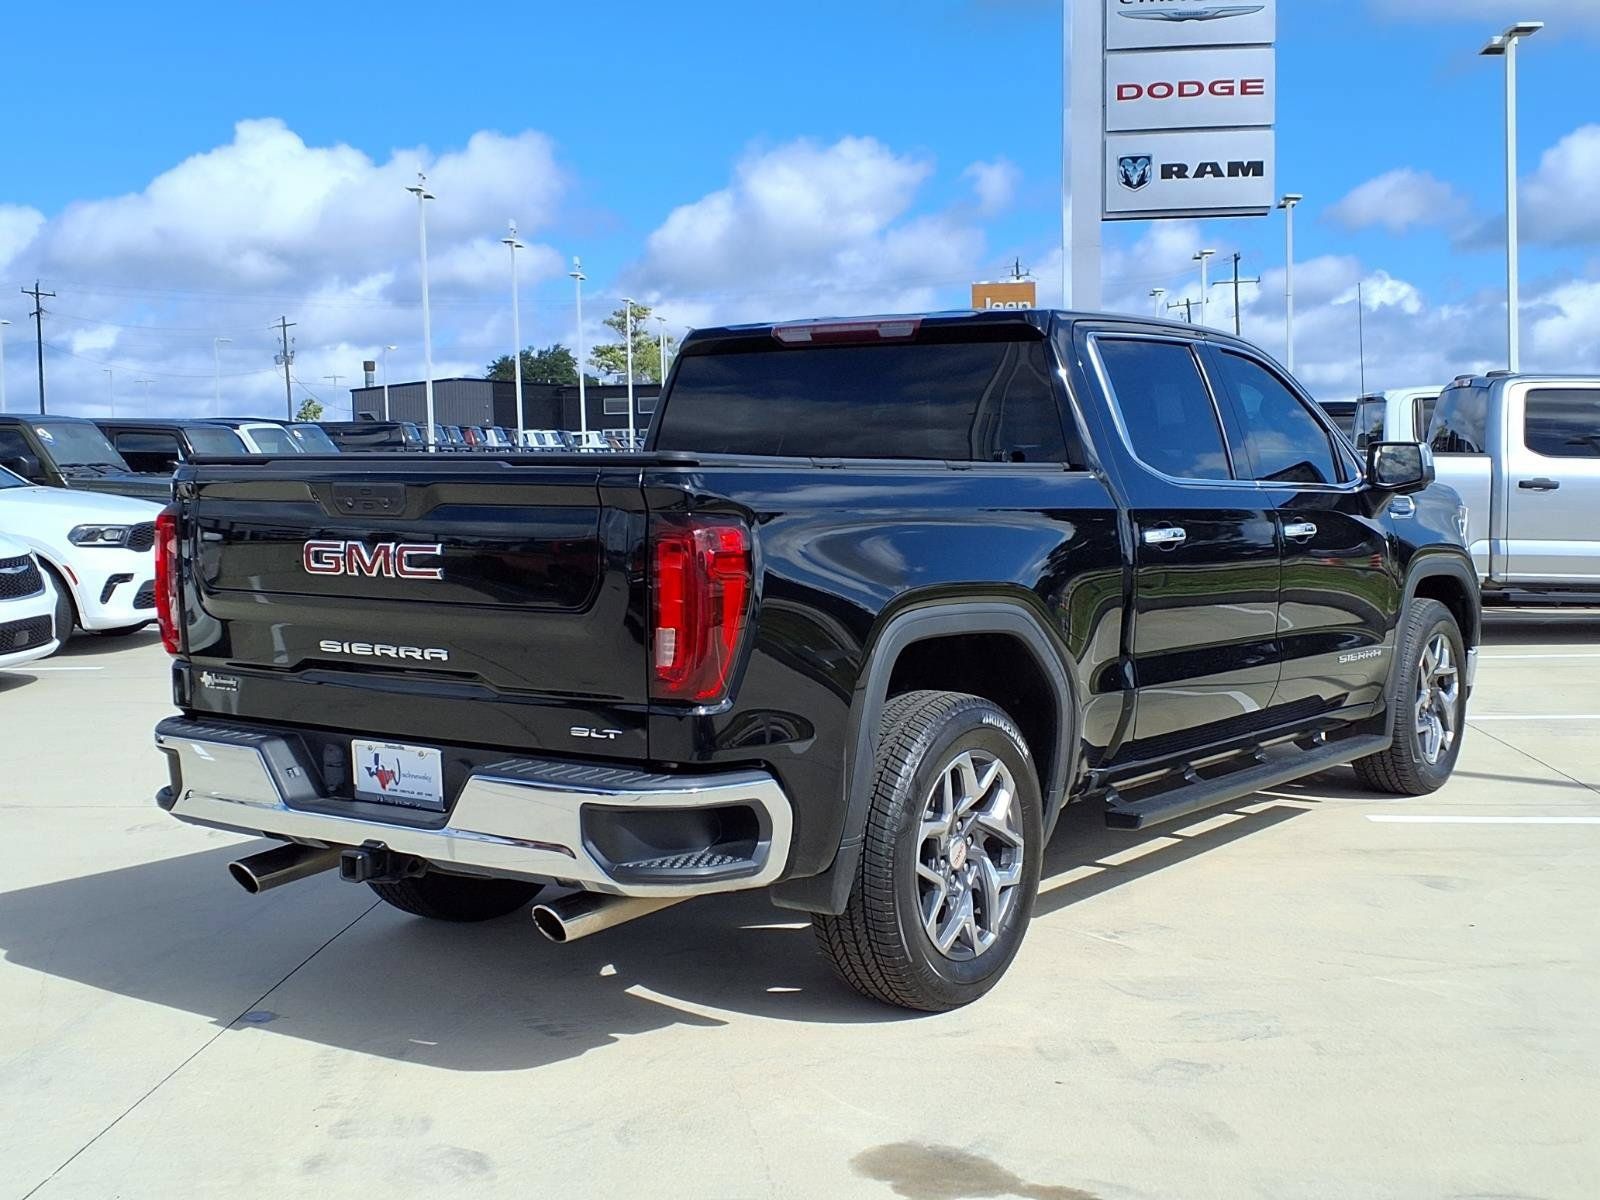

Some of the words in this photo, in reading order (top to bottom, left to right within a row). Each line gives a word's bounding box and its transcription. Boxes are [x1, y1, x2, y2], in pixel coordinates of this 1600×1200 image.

[1116, 78, 1265, 101] DODGE
[1160, 160, 1264, 180] RAM
[303, 539, 443, 580] GMC
[319, 639, 449, 661] SIERRA
[1338, 649, 1382, 664] SIERRA
[570, 726, 623, 739] SLT
